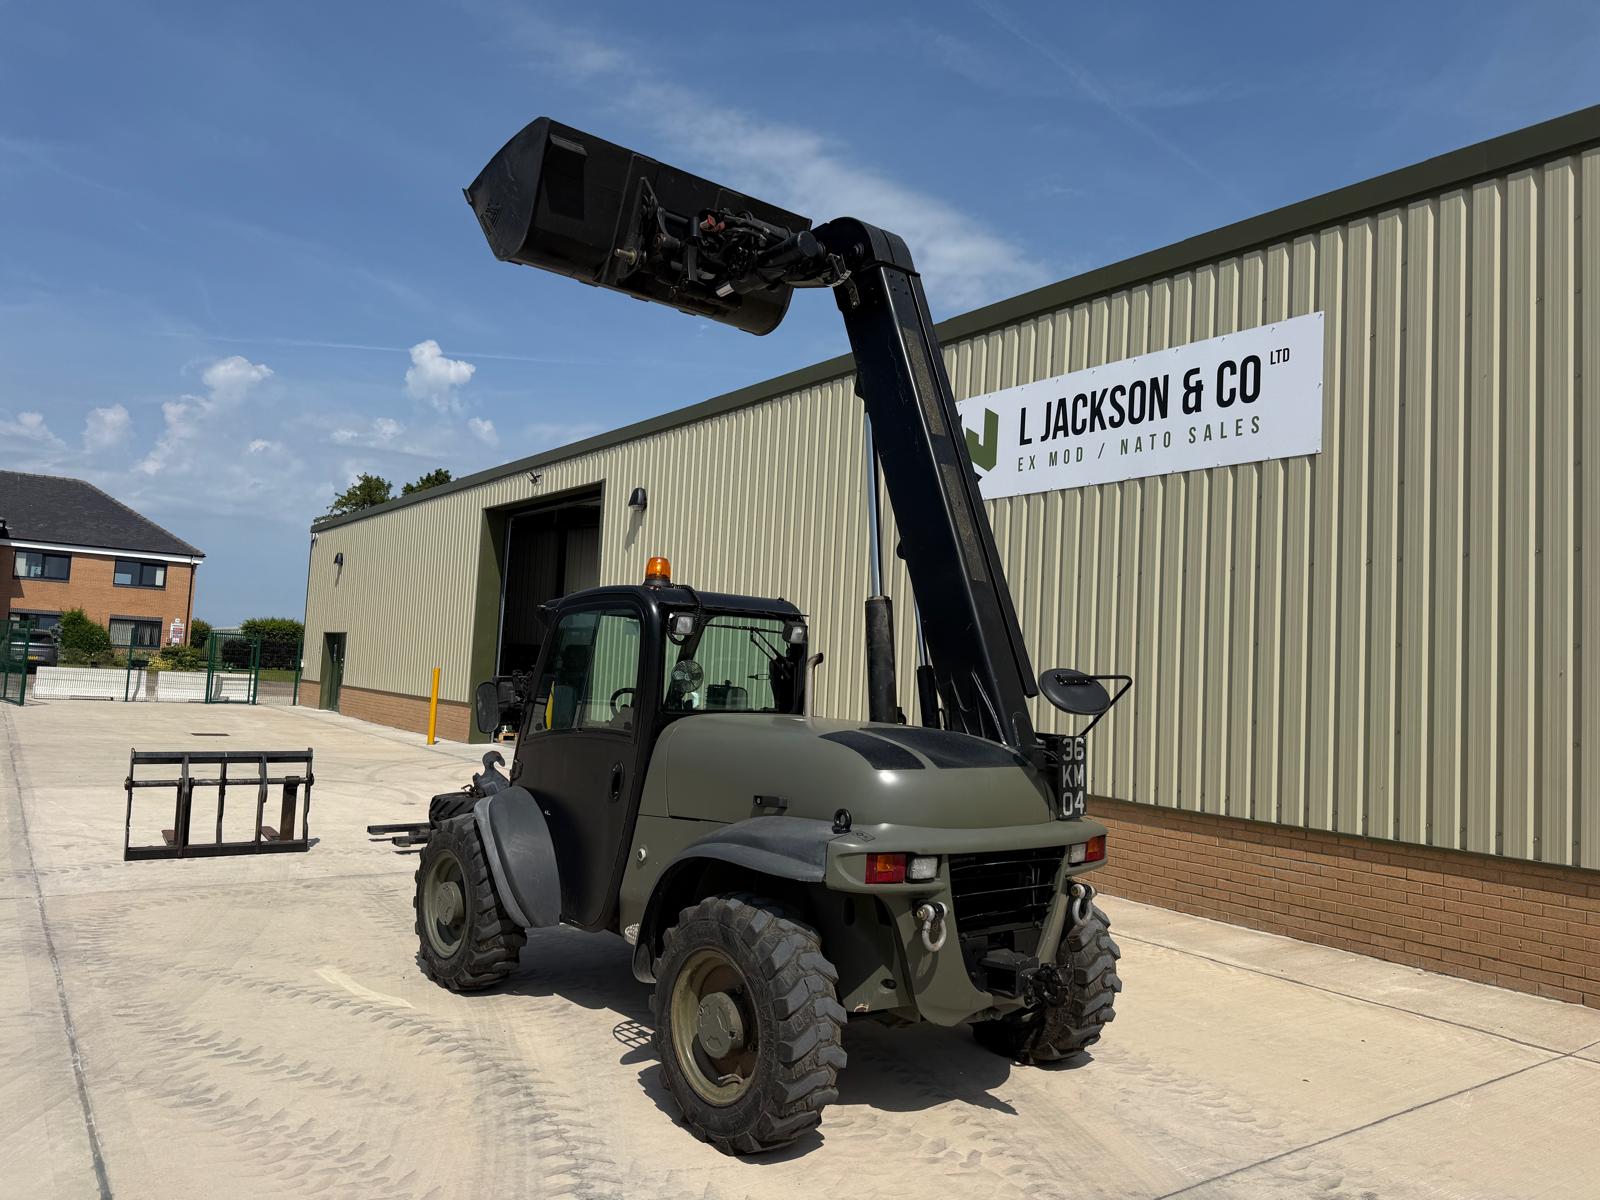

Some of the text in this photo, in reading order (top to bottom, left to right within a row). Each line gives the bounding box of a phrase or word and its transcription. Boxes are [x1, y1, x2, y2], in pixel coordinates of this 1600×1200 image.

[1019, 347, 1291, 447] L JACKSON & CO LTD
[1017, 454, 1036, 472] EX
[1048, 446, 1083, 467] MOD
[1120, 430, 1171, 456] NATO
[1188, 415, 1260, 445] SALES
[1062, 737, 1085, 761] 36
[1062, 763, 1085, 788] KM
[1062, 790, 1085, 816] 04
